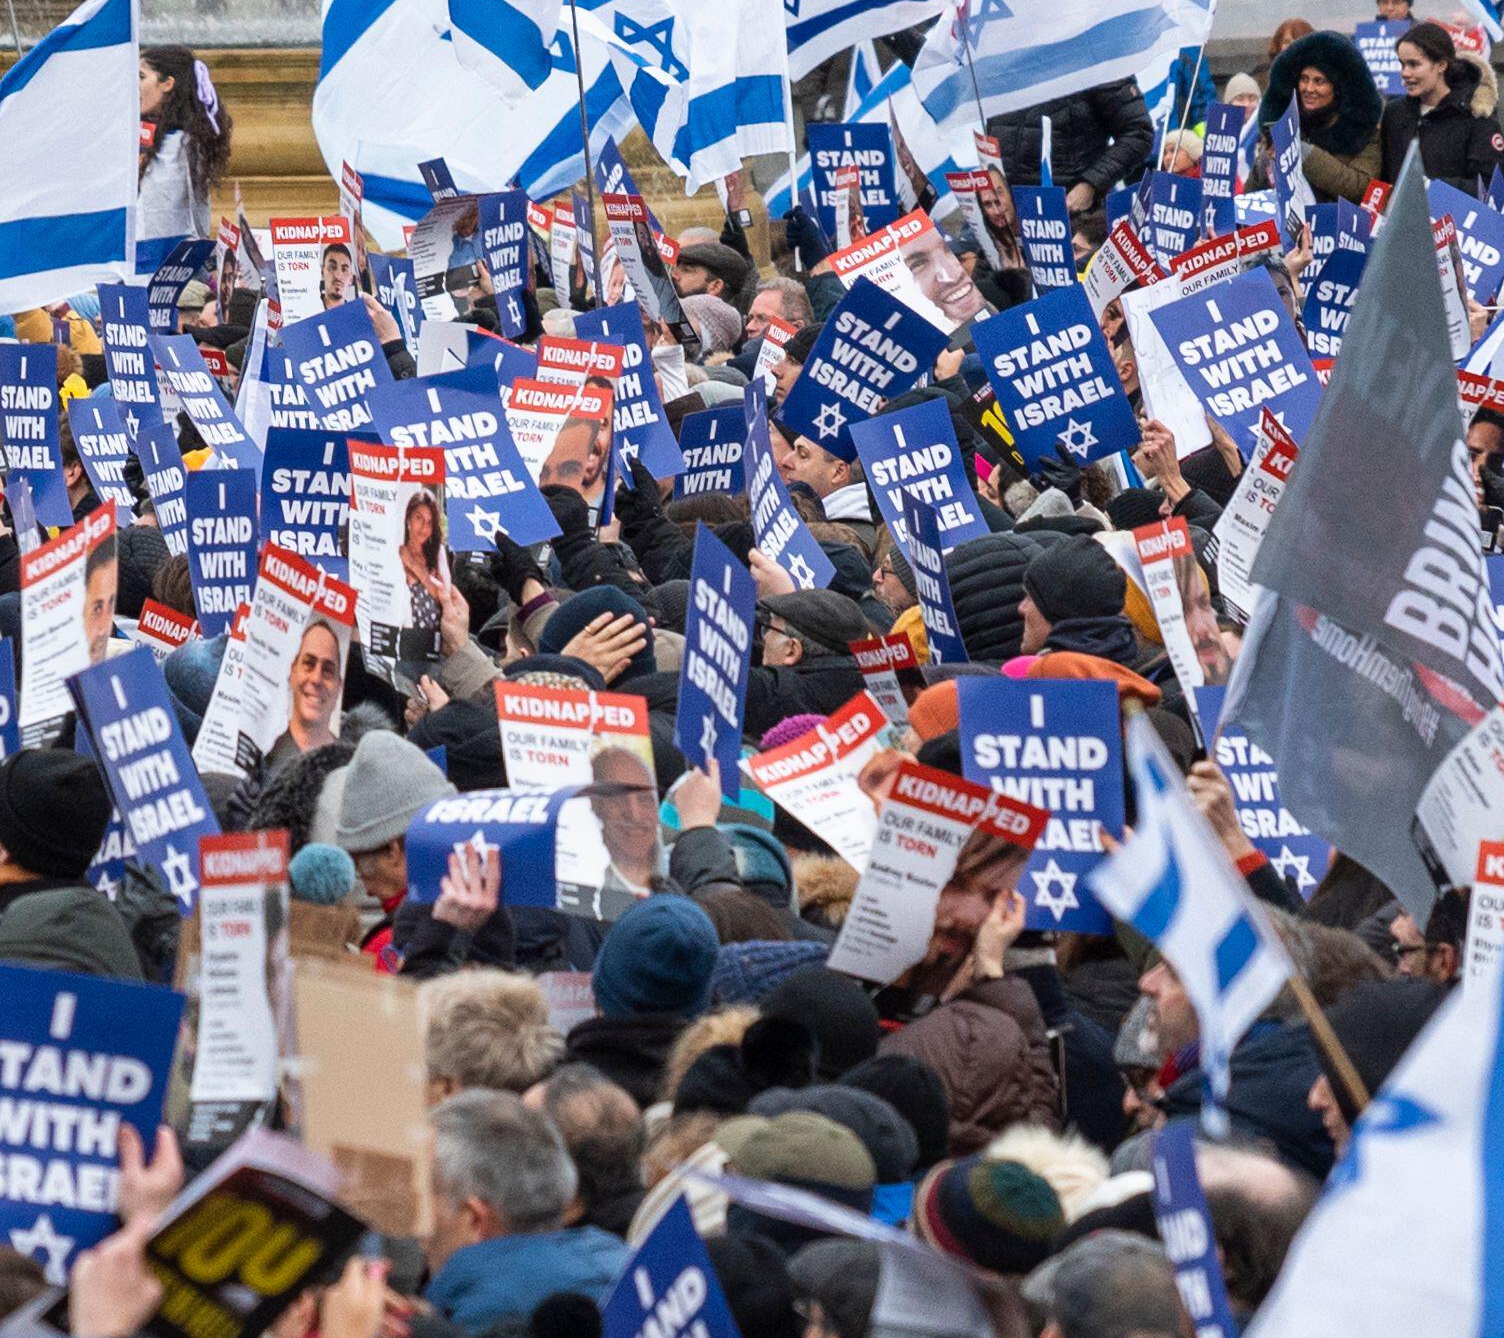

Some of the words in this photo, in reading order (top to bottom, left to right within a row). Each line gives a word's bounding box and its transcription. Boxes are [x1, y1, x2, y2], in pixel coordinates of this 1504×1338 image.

[817, 149, 885, 170] STAND
[275, 223, 344, 243] KIDNAPPED
[484, 223, 525, 246] STAND
[833, 213, 924, 276] KIDNAPPED
[1022, 218, 1066, 239] STAND
[287, 260, 310, 272] TORN
[105, 323, 146, 347] STAND
[993, 323, 1092, 379] STAND
[1179, 309, 1281, 366] STAND
[111, 352, 146, 376] WITH
[1013, 354, 1104, 399] WITH
[1200, 341, 1286, 388] WITH
[0, 386, 53, 410] STAND
[112, 380, 156, 404] ISRAEL
[514, 386, 602, 415] KIDNAPPED
[1014, 382, 1115, 432] ISRAEL
[1207, 360, 1309, 419] ISRAEL
[5, 416, 46, 439] WITH
[351, 454, 436, 477] KIDNAPPED
[25, 513, 111, 581] KIDNAPPED
[192, 516, 252, 544] STAND
[199, 551, 247, 579] WITH
[197, 584, 252, 614] ISRAEL
[266, 555, 350, 613] KIDNAPPED
[503, 694, 636, 729] KIDNAPPED
[99, 711, 172, 756] STAND
[972, 734, 1108, 772] STAND
[118, 749, 180, 800] WITH
[127, 791, 205, 842] ISRAEL
[895, 773, 1031, 838] KIDNAPPED
[896, 835, 939, 859] TORN
[49, 991, 73, 1039] I
[633, 1267, 654, 1309] I
